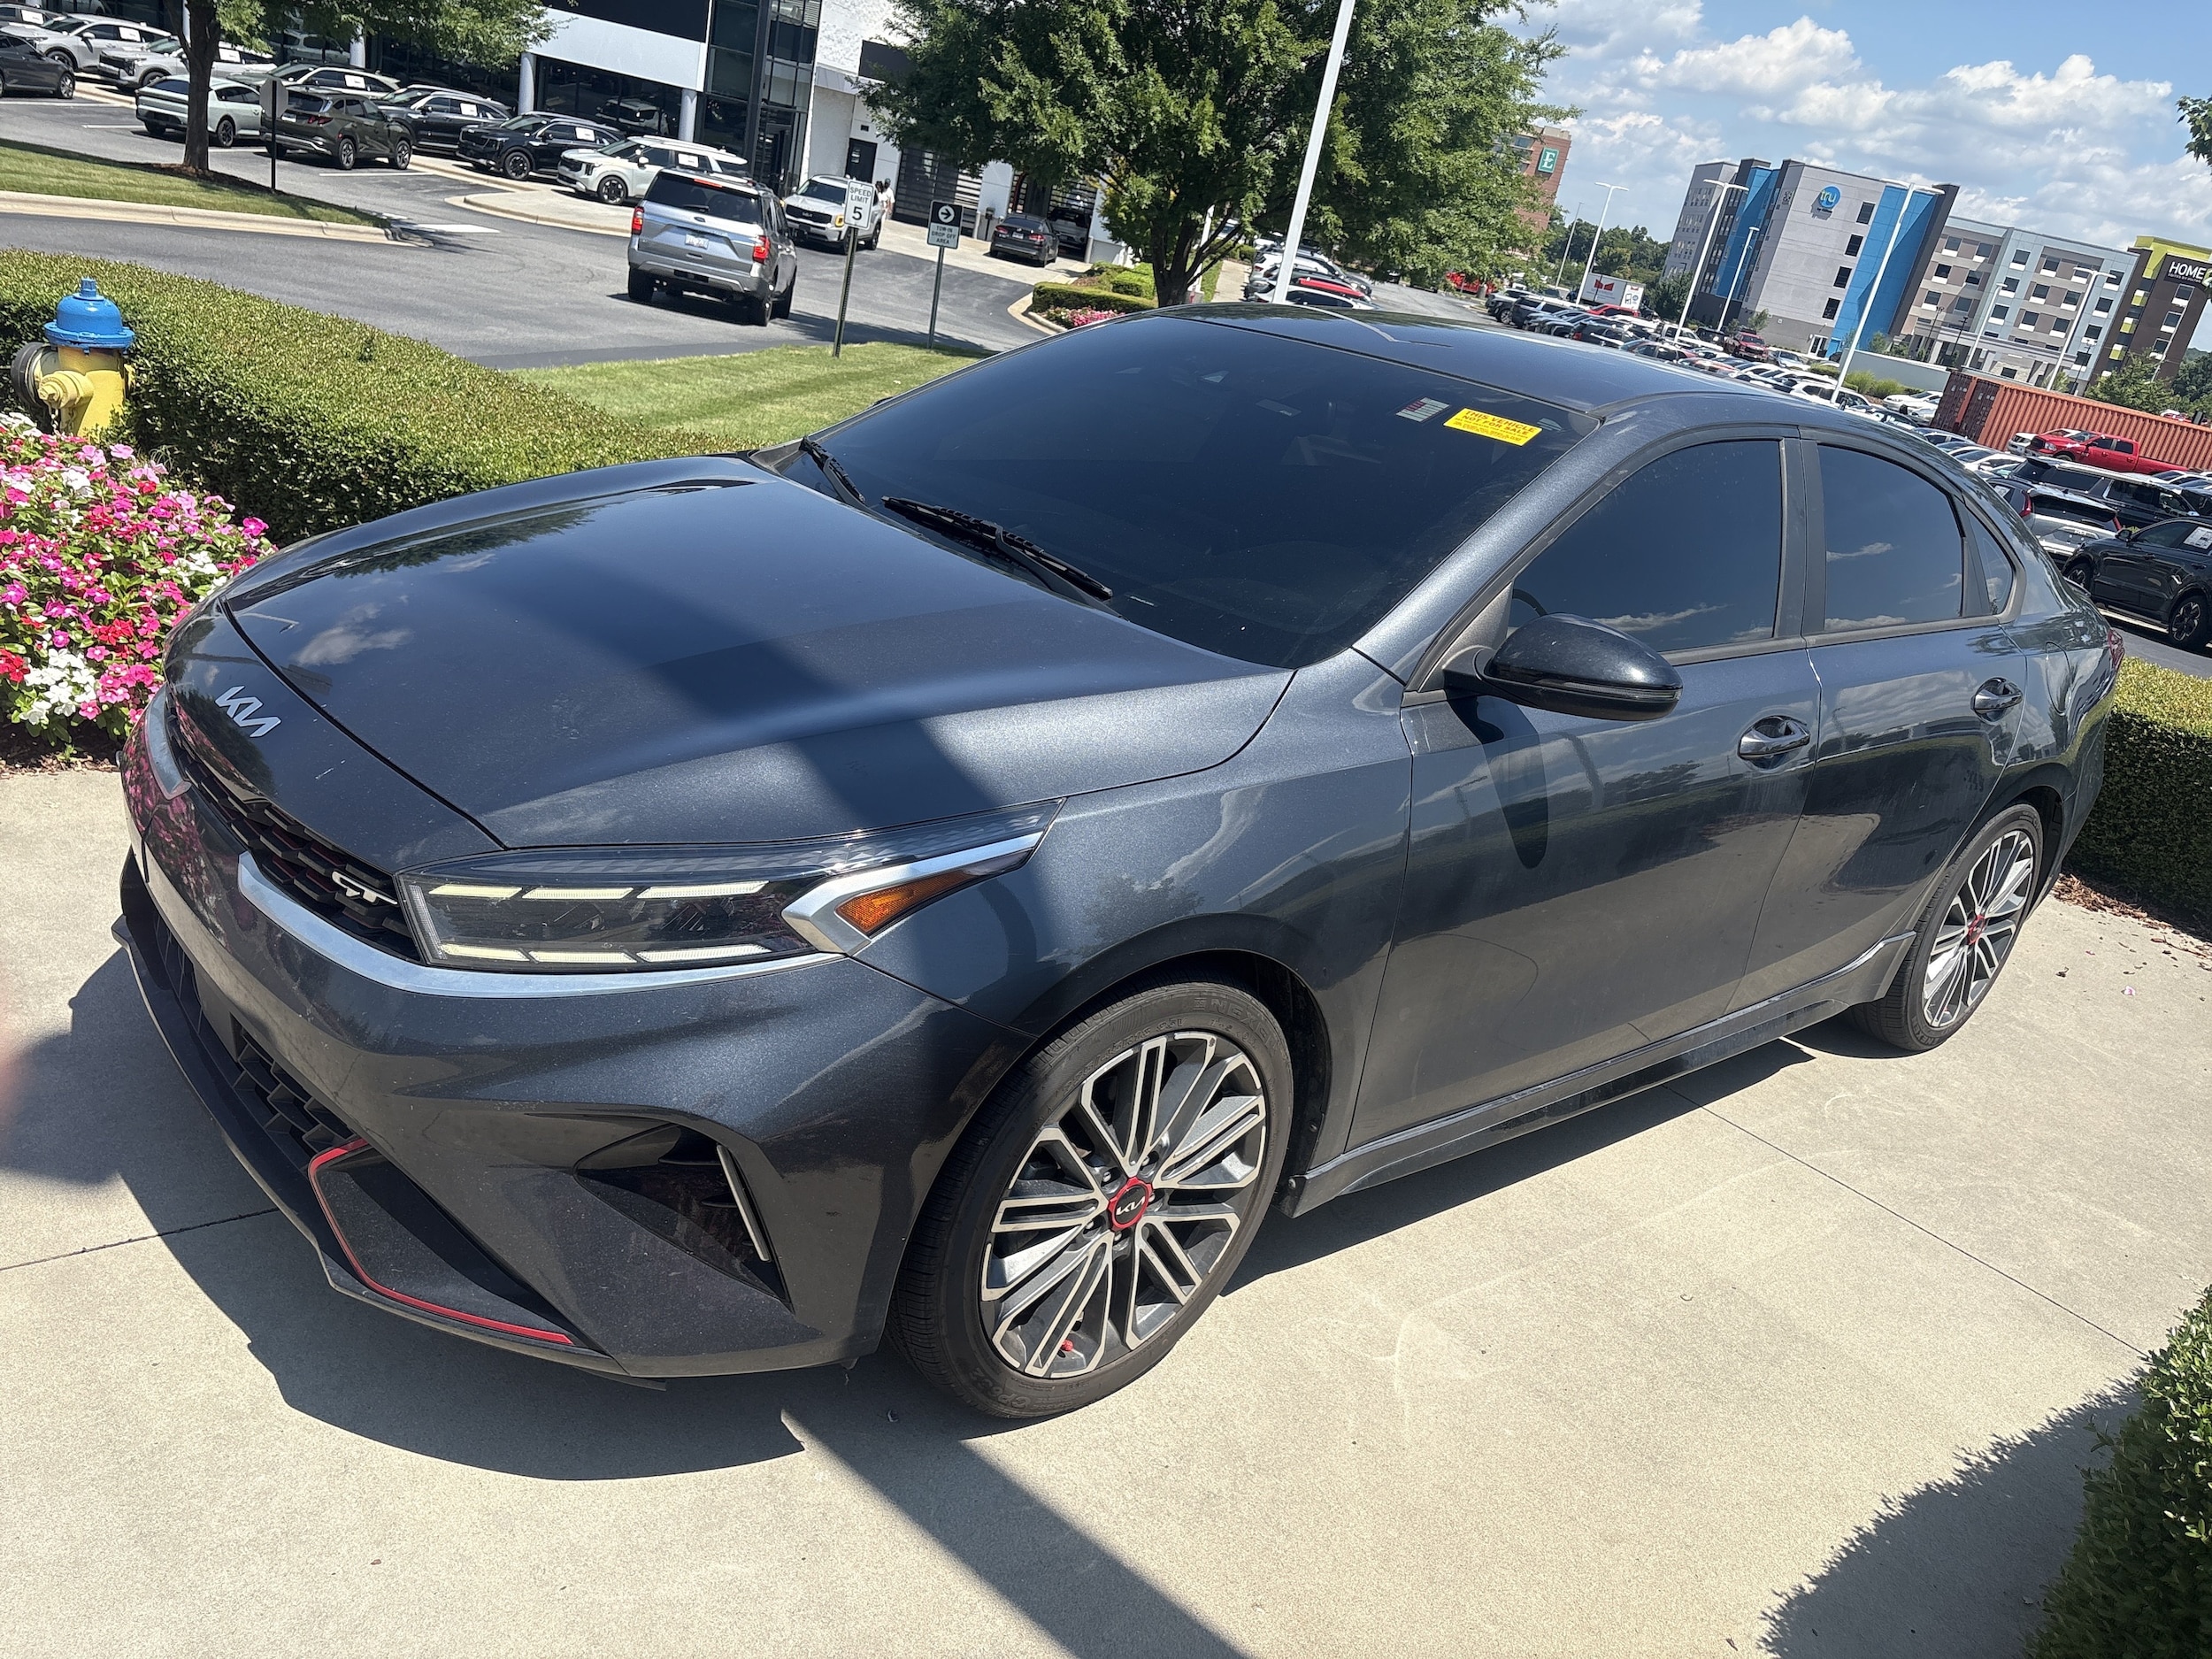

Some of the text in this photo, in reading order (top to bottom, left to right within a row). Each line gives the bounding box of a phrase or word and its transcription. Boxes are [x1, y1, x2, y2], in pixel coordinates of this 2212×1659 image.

[849, 187, 872, 197] SPEED
[850, 195, 869, 204] LIMIT
[1820, 189, 1837, 203] tru
[852, 206, 863, 220] 5
[1461, 415, 1481, 424] NOT
[1482, 420, 1502, 429] FOR
[1505, 426, 1531, 436] SALE
[1464, 411, 1489, 420] THIS
[1491, 417, 1538, 433] VEHICLE
[215, 685, 282, 738] KIA
[331, 871, 398, 903] GT
[1116, 1195, 1146, 1216] KIA
